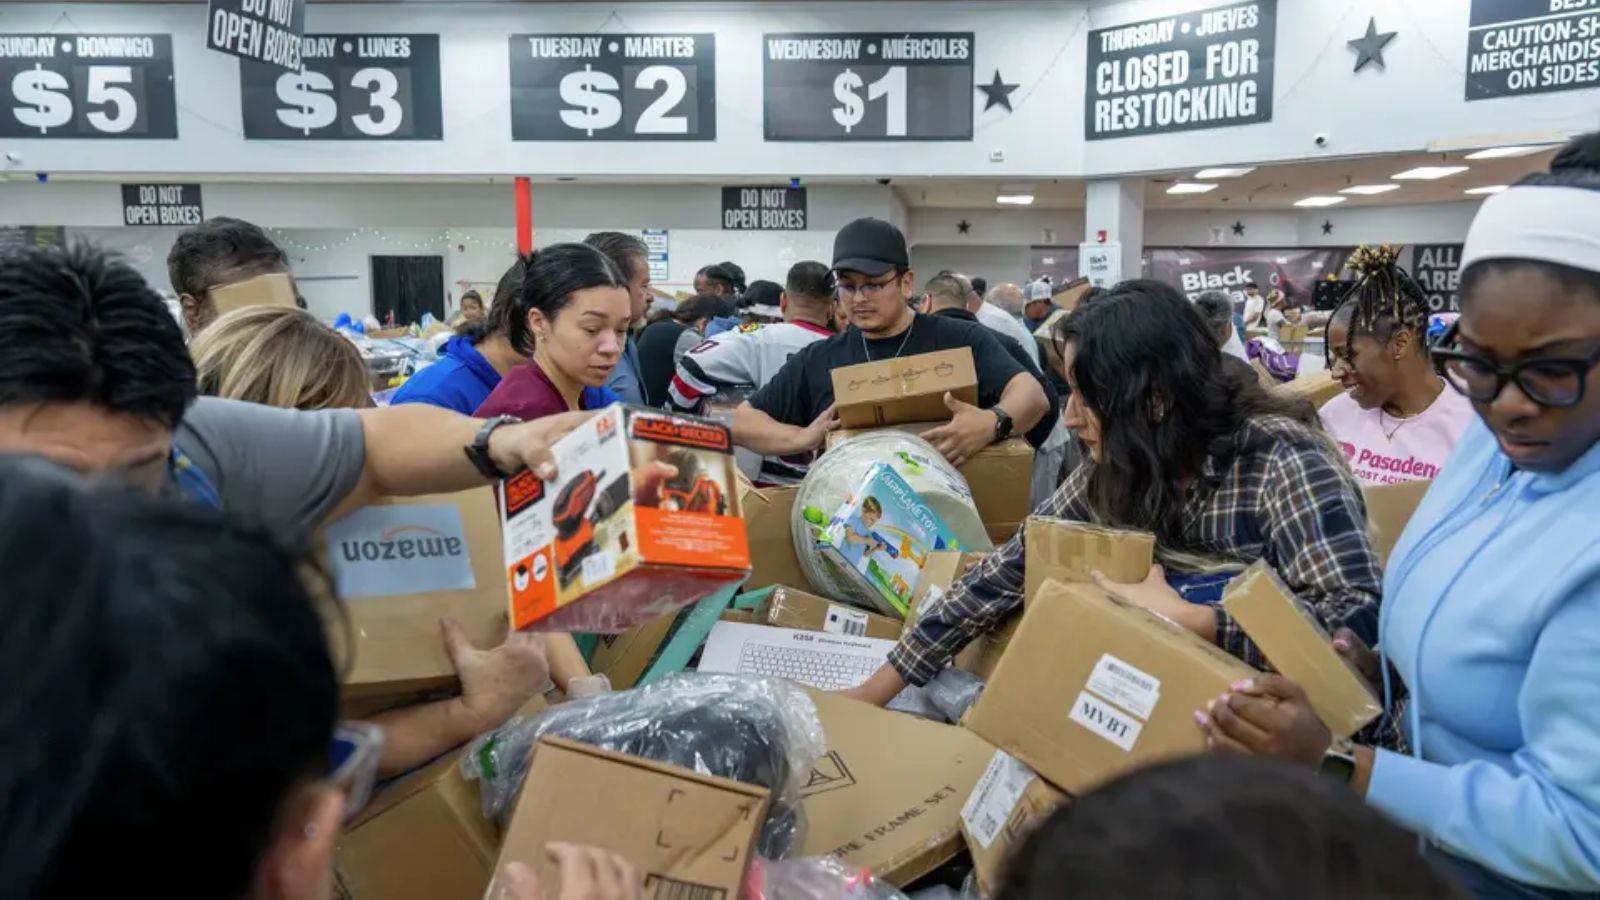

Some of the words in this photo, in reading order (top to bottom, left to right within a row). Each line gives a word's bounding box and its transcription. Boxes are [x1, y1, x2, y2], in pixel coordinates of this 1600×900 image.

[213, 8, 264, 58] OPEN
[263, 25, 301, 71] BOXES
[1100, 19, 1176, 53] THURSDAY
[1196, 4, 1259, 36] JUEVES
[0, 37, 56, 57] SUNDAY
[76, 37, 154, 58] DOMINGO
[302, 37, 336, 58] DAY
[358, 37, 411, 58] LUNES
[529, 37, 603, 58] TUESDAY
[624, 37, 695, 58] MARTES
[768, 38, 862, 59] WEDNESDAY
[882, 34, 969, 59] MIÉRCOLES
[1471, 38, 1600, 73] MERCHANDIS
[1096, 50, 1190, 95] CLOSED
[1206, 39, 1259, 80] FOR
[1507, 68, 1537, 90] ON
[1541, 60, 1600, 86] SIDES
[832, 66, 907, 136] $1
[1095, 80, 1258, 133] RESTOCKING
[140, 185, 157, 204] DO
[159, 185, 183, 204] NOT
[741, 188, 759, 208] DO
[761, 188, 787, 208] NOT
[126, 205, 159, 225] OPEN
[160, 205, 201, 225] BOXES
[725, 209, 759, 228] OPEN
[761, 209, 804, 228] BOXES
[1418, 247, 1458, 268] ALL
[1181, 265, 1254, 291] Black
[1418, 270, 1460, 291] ARE
[341, 536, 462, 562] amazon
[1080, 701, 1132, 738] MVBT
[864, 806, 927, 842] FRAME
[924, 784, 957, 806] SET
